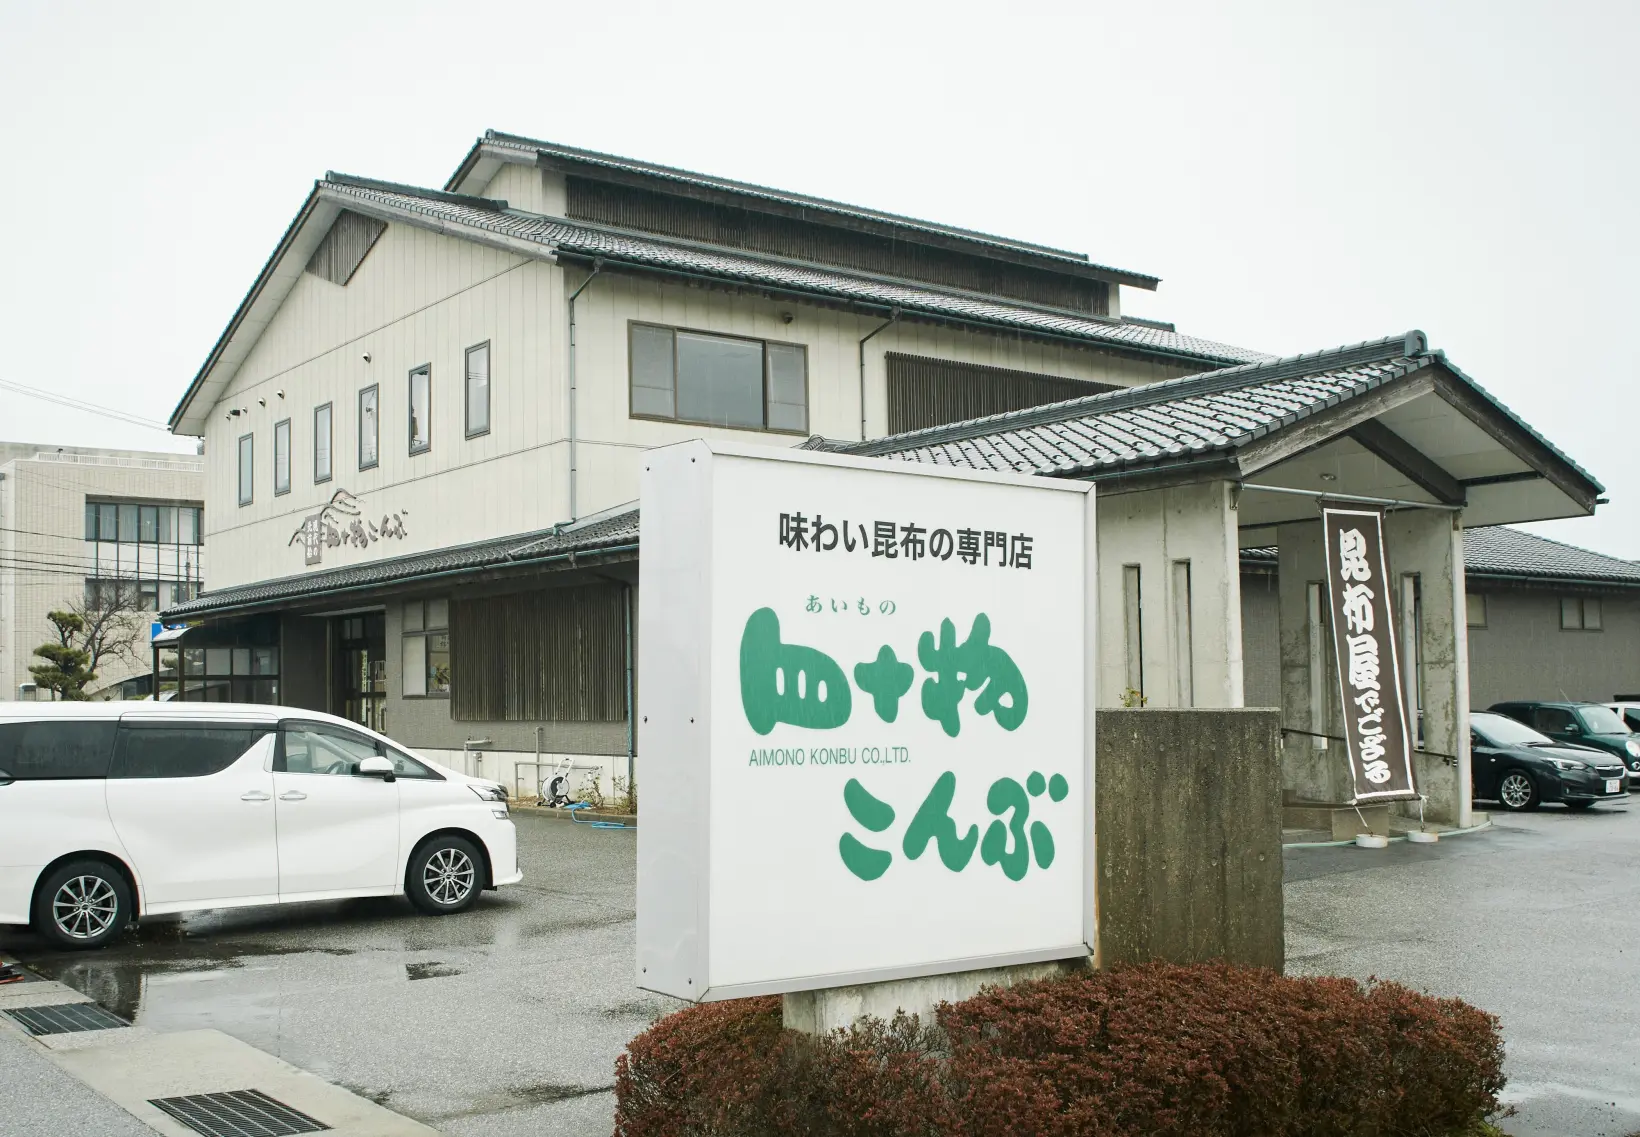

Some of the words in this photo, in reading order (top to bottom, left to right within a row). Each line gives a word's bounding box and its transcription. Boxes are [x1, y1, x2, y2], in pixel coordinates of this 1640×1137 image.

[779, 512, 1033, 569] 味わい昆布の専門店
[806, 595, 896, 616] あいもの
[740, 607, 1029, 737] 四十物
[749, 749, 805, 766] AIMONO
[811, 748, 856, 765] KONBU
[861, 747, 911, 765] CO.,LTD.
[839, 771, 1068, 881] こんぶ
